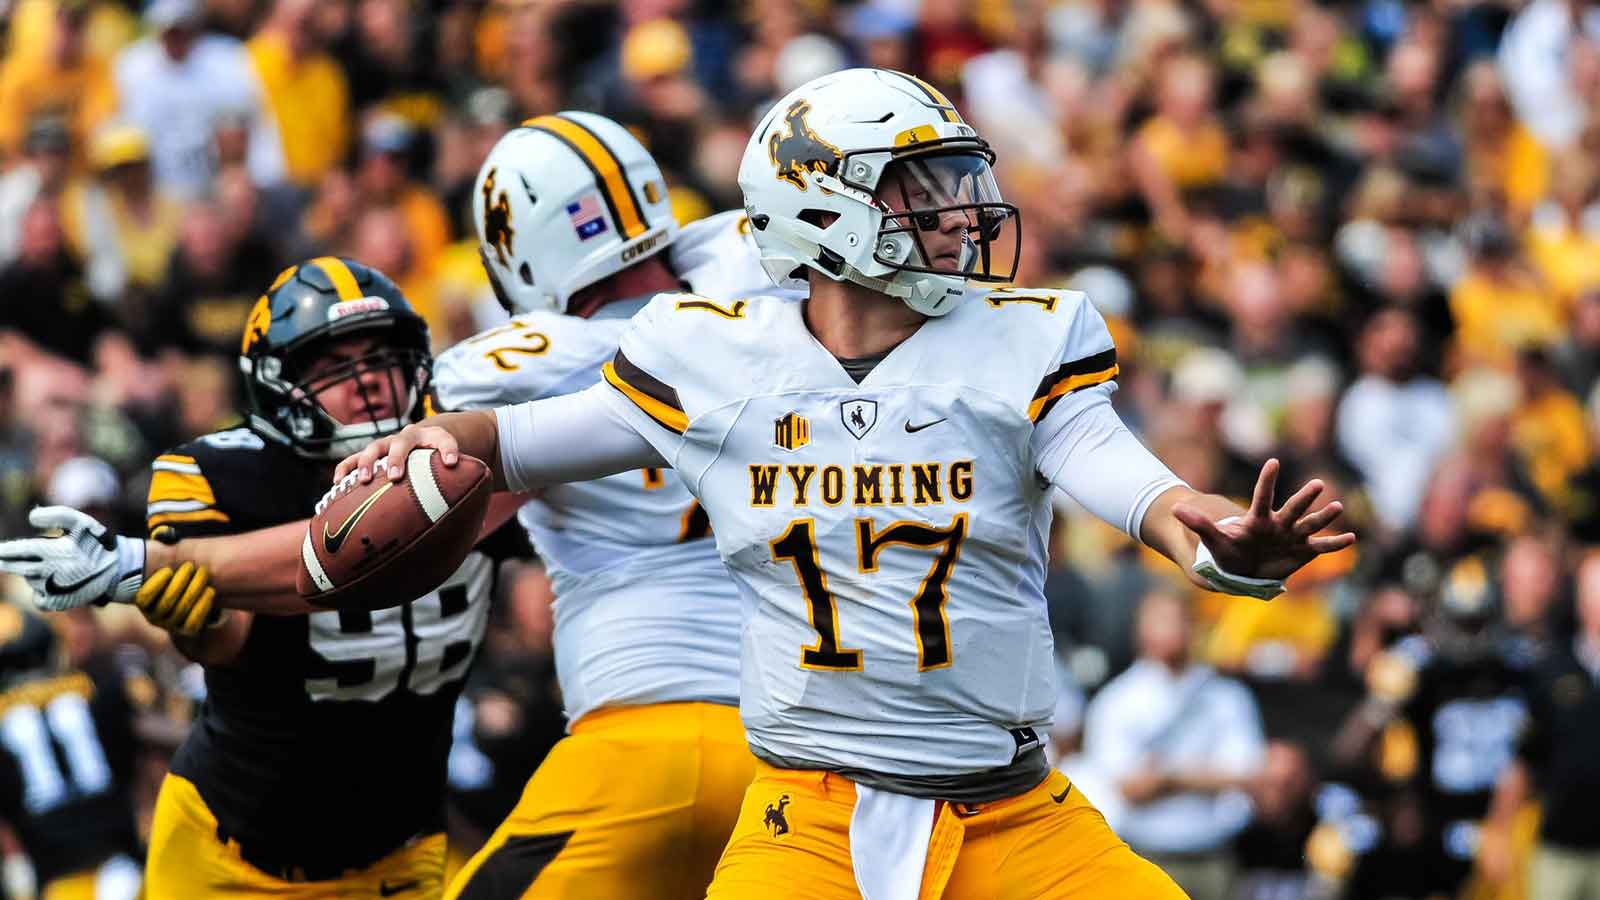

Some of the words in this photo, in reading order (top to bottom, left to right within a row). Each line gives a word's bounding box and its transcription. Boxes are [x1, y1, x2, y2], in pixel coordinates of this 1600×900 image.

[749, 460, 976, 507] WYOMING
[304, 551, 493, 703] 98
[768, 511, 969, 672] 17
